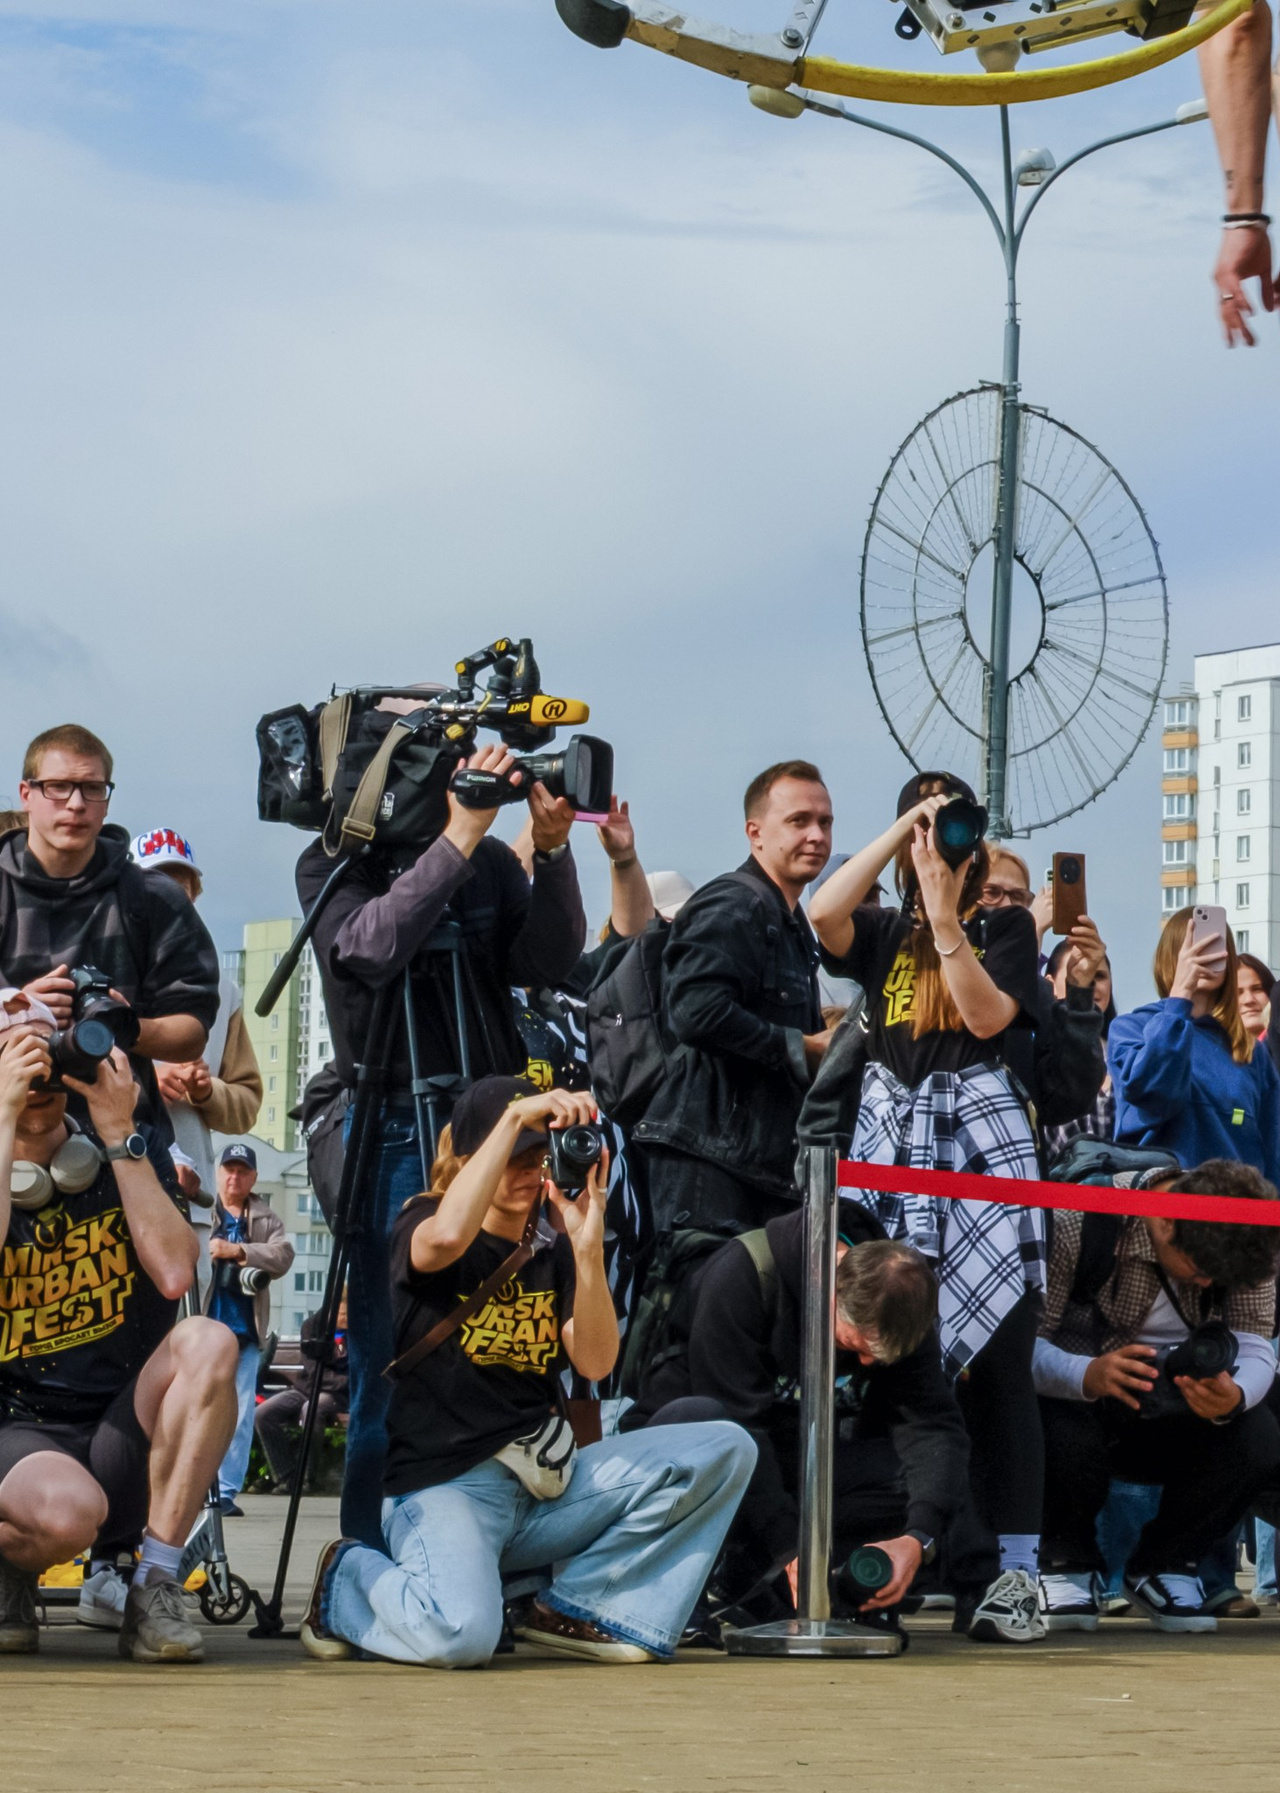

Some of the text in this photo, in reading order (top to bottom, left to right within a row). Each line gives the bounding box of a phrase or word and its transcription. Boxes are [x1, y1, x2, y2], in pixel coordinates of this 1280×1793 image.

[0, 1242, 128, 1308] URBAN
[3, 1213, 118, 1277] MINSK
[9, 1278, 120, 1351] FEST
